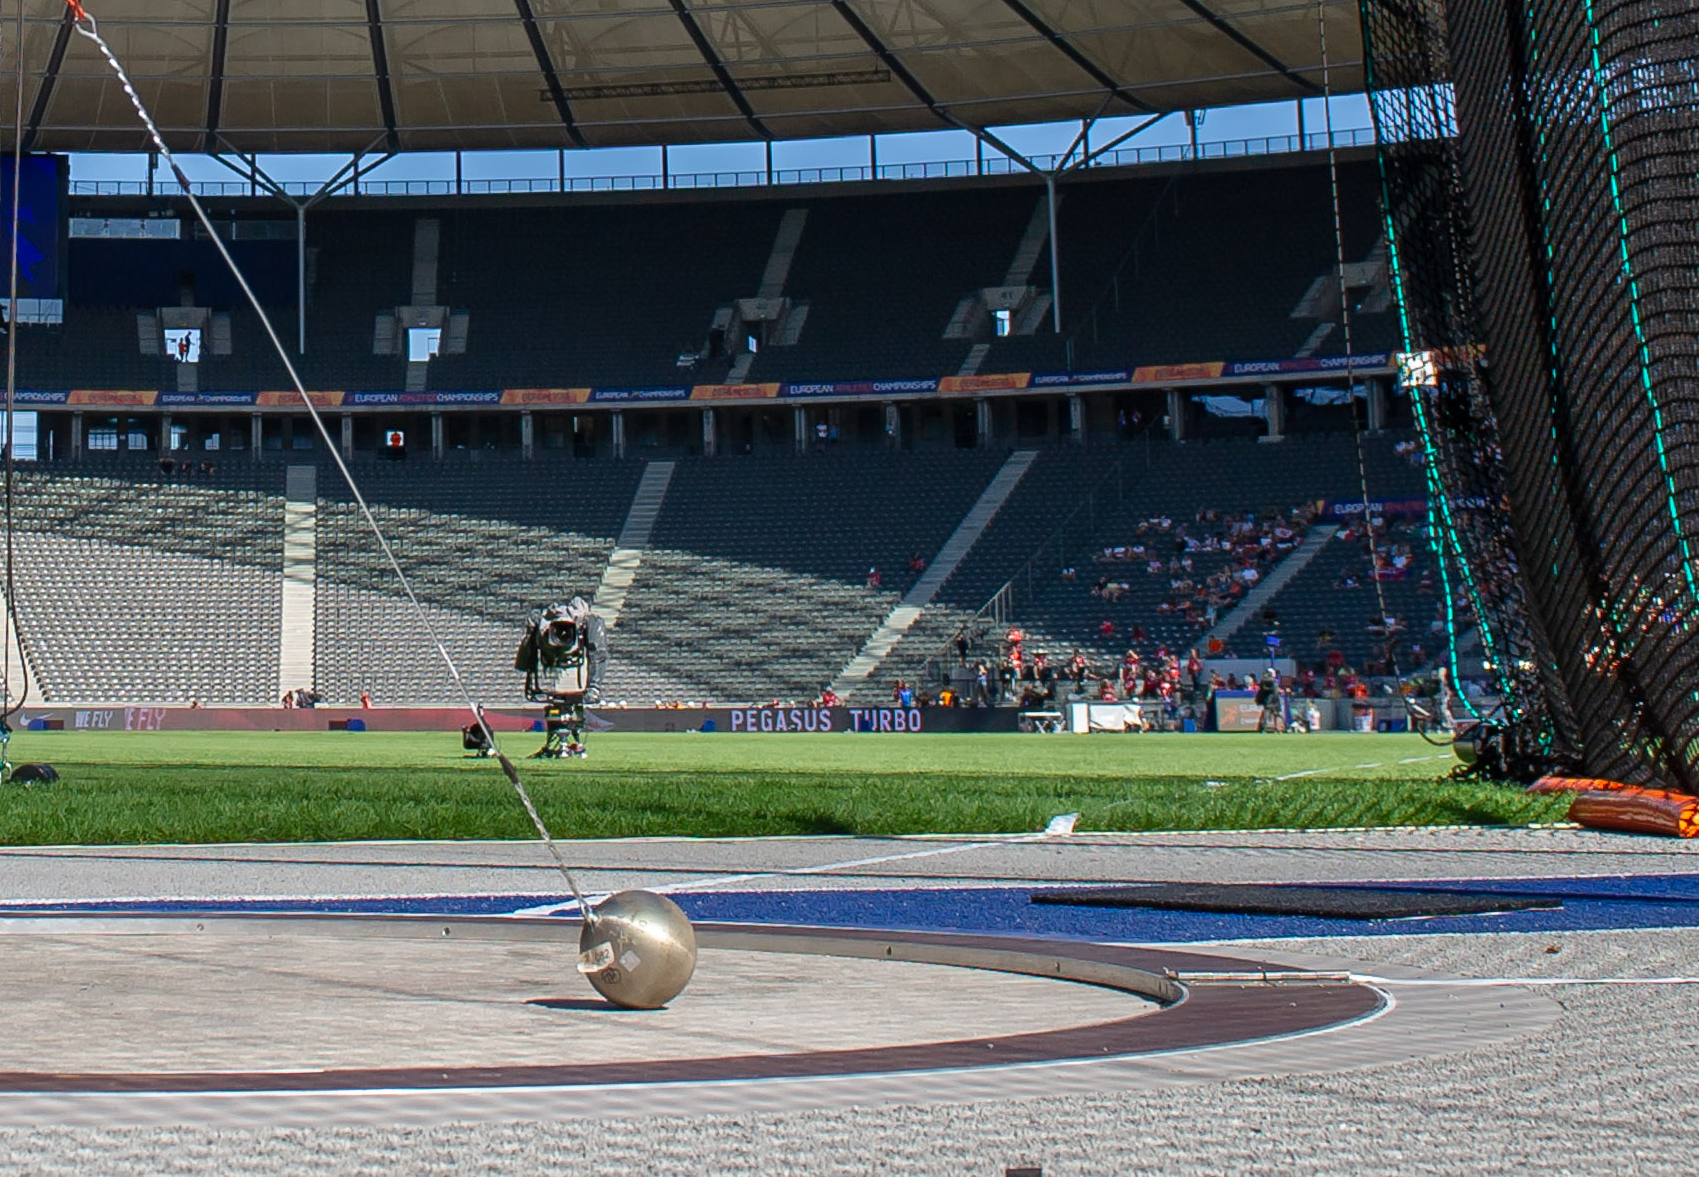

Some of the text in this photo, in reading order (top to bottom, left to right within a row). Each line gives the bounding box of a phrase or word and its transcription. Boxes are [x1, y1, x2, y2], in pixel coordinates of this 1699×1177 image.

[1320, 354, 1386, 368] CHAMPONSHIPS
[790, 384, 834, 394] EUROPEAN
[873, 380, 936, 391] CHAMPIONSHIPS
[4, 392, 66, 402] CAMPIONSHIPS
[355, 393, 398, 402] EUROPEAN
[437, 393, 498, 402] CHAMPIONSHIPS
[91, 710, 114, 728] FLY
[137, 707, 167, 730] FLY
[730, 709, 922, 732] PEGASUS TURBO
